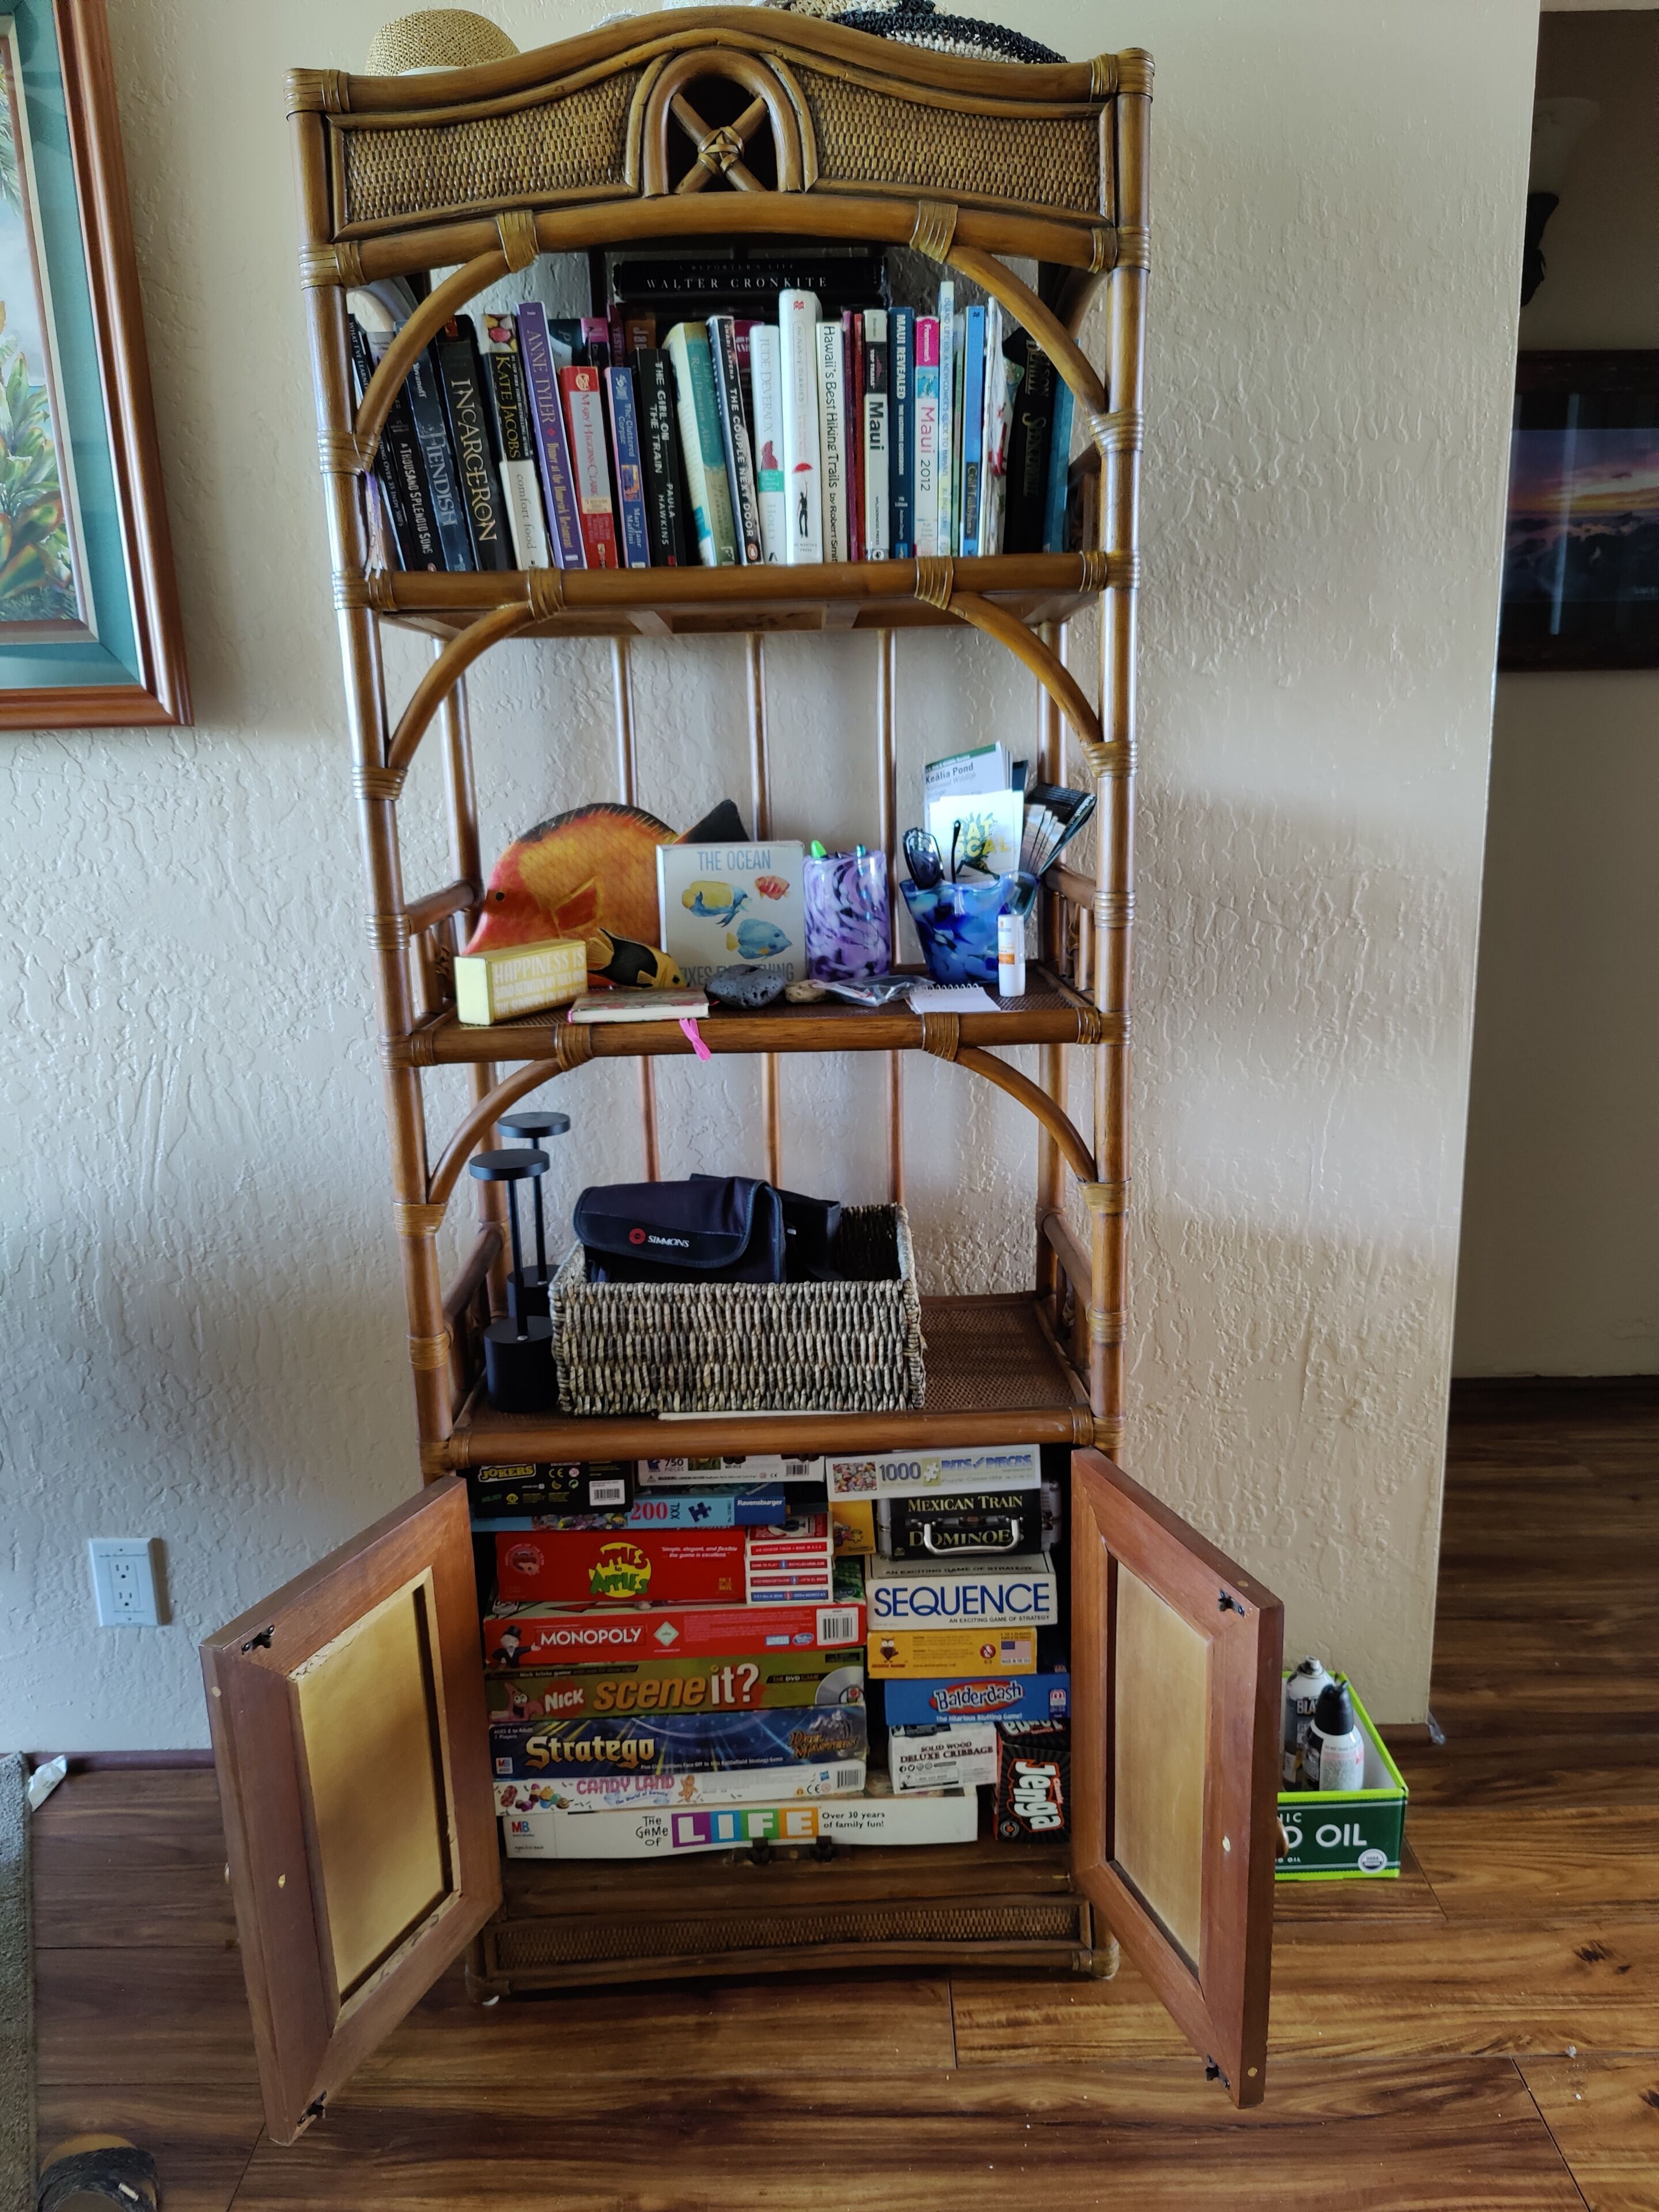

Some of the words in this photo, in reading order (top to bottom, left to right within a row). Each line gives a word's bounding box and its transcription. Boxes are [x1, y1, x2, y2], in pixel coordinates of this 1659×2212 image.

[646, 278, 719, 290] WALTER
[730, 276, 827, 288] CRONKITE
[349, 321, 357, 342] WHAT
[724, 324, 732, 349] SHARI
[896, 314, 907, 344] MAUI
[527, 329, 548, 373] ANNE
[726, 350, 735, 380] LAPENA
[759, 338, 771, 369] JUDE
[823, 325, 837, 378] Hawaii's
[495, 354, 513, 401] KATE
[655, 361, 665, 386] THE
[896, 346, 907, 400] REVEALED
[535, 379, 556, 424] TYLER
[580, 393, 592, 423] MARY
[624, 403, 632, 414] The
[657, 390, 668, 420] GIRL
[730, 388, 740, 411] THE
[760, 371, 774, 433] DEVERAUX
[825, 381, 837, 410] Best
[497, 403, 521, 459] JACOBS
[618, 416, 627, 445] Corpse
[649, 404, 660, 430] THE
[660, 422, 670, 441] ON
[869, 401, 885, 451] Maui
[920, 406, 935, 454] Maui
[584, 423, 596, 465] HIGGINS
[626, 419, 637, 458] Cluttered
[732, 415, 745, 463] COUPLE
[826, 413, 839, 452] Hiking
[451, 378, 498, 541] INCARCERON
[652, 434, 662, 474] TRAIN
[383, 461, 392, 480] OVER
[388, 480, 396, 490] 35
[399, 448, 419, 492] THOUSAND
[416, 424, 459, 527] FIENDISH
[587, 464, 600, 496] CLARK
[738, 468, 750, 498] NEXT
[828, 453, 840, 488] Trails
[920, 459, 931, 492] 2012
[390, 490, 400, 509] INDY
[410, 491, 429, 532] SPLENDID
[516, 474, 532, 519] comfort
[524, 521, 537, 550] food
[666, 483, 676, 518] PAULA
[830, 493, 837, 503] by
[658, 495, 669, 546] HAWKINS
[743, 503, 755, 537] DOOR
[767, 505, 777, 540] HOLLY
[419, 531, 434, 555] SUNS
[952, 762, 974, 775] Pond
[697, 851, 724, 872] THE
[727, 849, 772, 871] OCEAN
[494, 950, 569, 984] HAPPINESS
[573, 947, 584, 968] IS
[647, 1234, 690, 1248] SIMMONS
[481, 1465, 533, 1480] JOKERS
[664, 1458, 684, 1467] 750
[878, 1462, 921, 1482] 1000
[941, 1458, 972, 1469] BITS
[986, 1455, 1032, 1469] PIECES
[630, 1501, 668, 1521] 200
[670, 1502, 681, 1520] XXL
[737, 1499, 783, 1507] Ravensburger
[907, 1498, 975, 1512] MEXICAN
[978, 1495, 1024, 1510] TRAIN
[873, 1583, 1050, 1617] SEQUENCE
[540, 1627, 642, 1646] MONOPOLY
[593, 1676, 706, 1711] scene
[710, 1662, 760, 1705] it?
[935, 1682, 1022, 1710] Balderdash
[524, 1736, 656, 1770] Stratego
[900, 1752, 941, 1764] DELUXE
[942, 1746, 994, 1759] CRIBBAGE
[946, 1741, 972, 1750] WOOD
[576, 1777, 631, 1795] CANDY
[635, 1775, 675, 1791] LAND
[1014, 1761, 1062, 1831] Jenga
[511, 1821, 530, 1833] MB
[676, 1810, 813, 1844] LIFE
[821, 1812, 845, 1820] Over
[847, 1810, 858, 1819] 30
[861, 1812, 885, 1821] years
[823, 1820, 833, 1828] of
[835, 1820, 864, 1830] family
[866, 1820, 884, 1828] fun!
[1315, 1823, 1368, 1848] OIL
